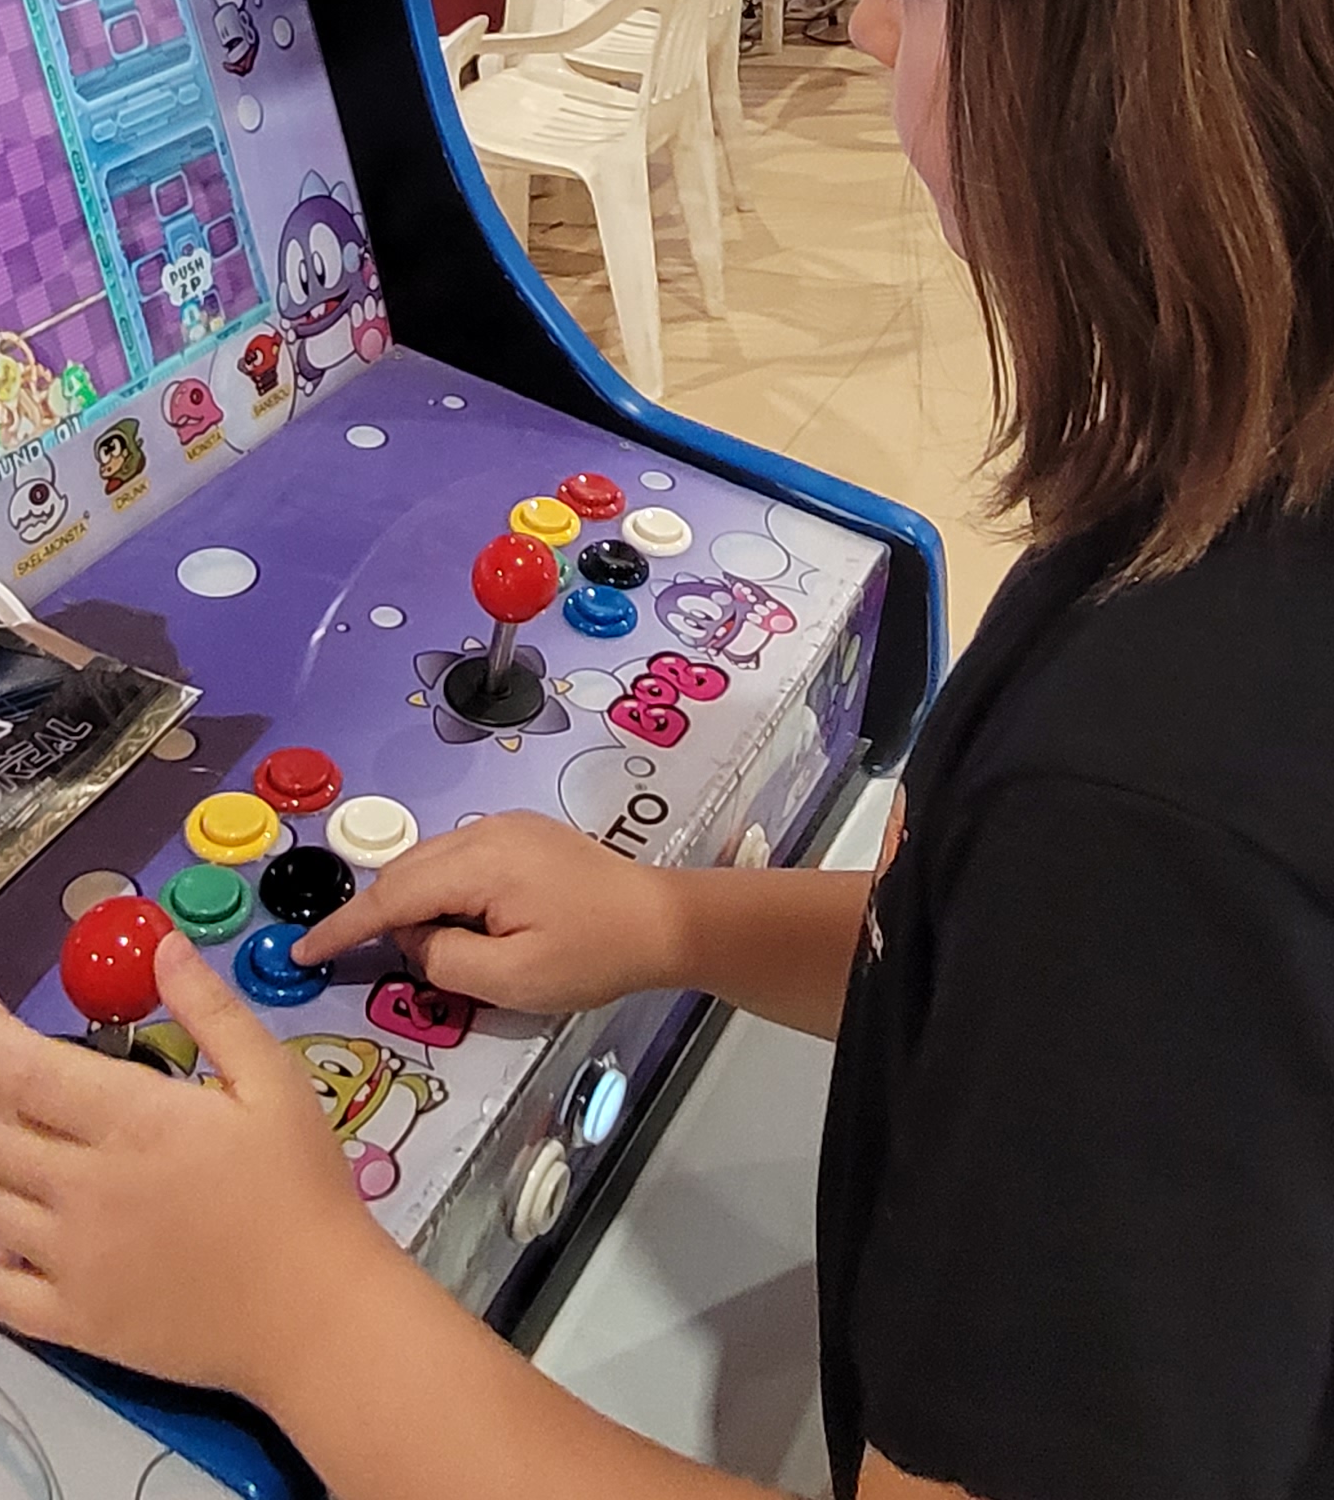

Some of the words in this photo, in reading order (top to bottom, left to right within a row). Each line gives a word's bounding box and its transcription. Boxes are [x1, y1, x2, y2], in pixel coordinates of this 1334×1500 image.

[169, 257, 204, 286] PUSH
[56, 417, 81, 445] 01
[186, 430, 223, 461] MONSTA
[115, 482, 147, 510] DRUNK
[17, 522, 87, 575] SKEL-MONSTA
[607, 651, 730, 748] BOB
[600, 792, 669, 860] ITO
